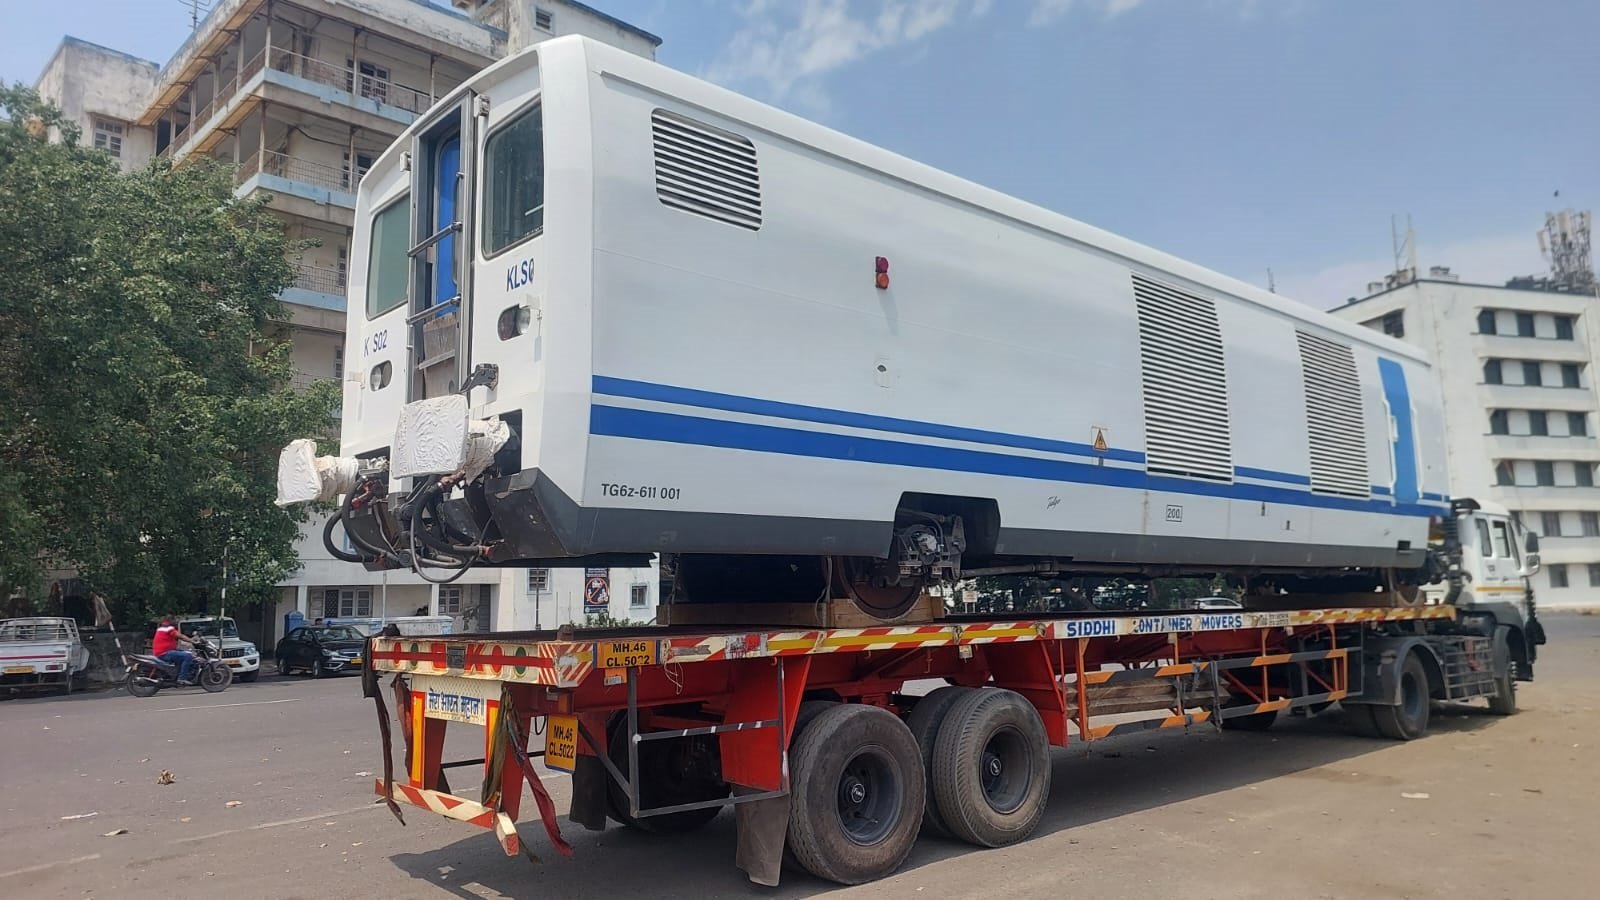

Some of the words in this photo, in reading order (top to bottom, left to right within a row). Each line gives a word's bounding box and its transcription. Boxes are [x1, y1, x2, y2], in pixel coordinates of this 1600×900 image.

[363, 329, 388, 358] KS02
[601, 483, 657, 498] TG6z-611
[660, 487, 680, 500] 001
[1167, 508, 1180, 519] 200
[1066, 619, 1116, 637] SIDDHI
[1201, 615, 1242, 629] MOVERS
[612, 642, 646, 653] MH.46
